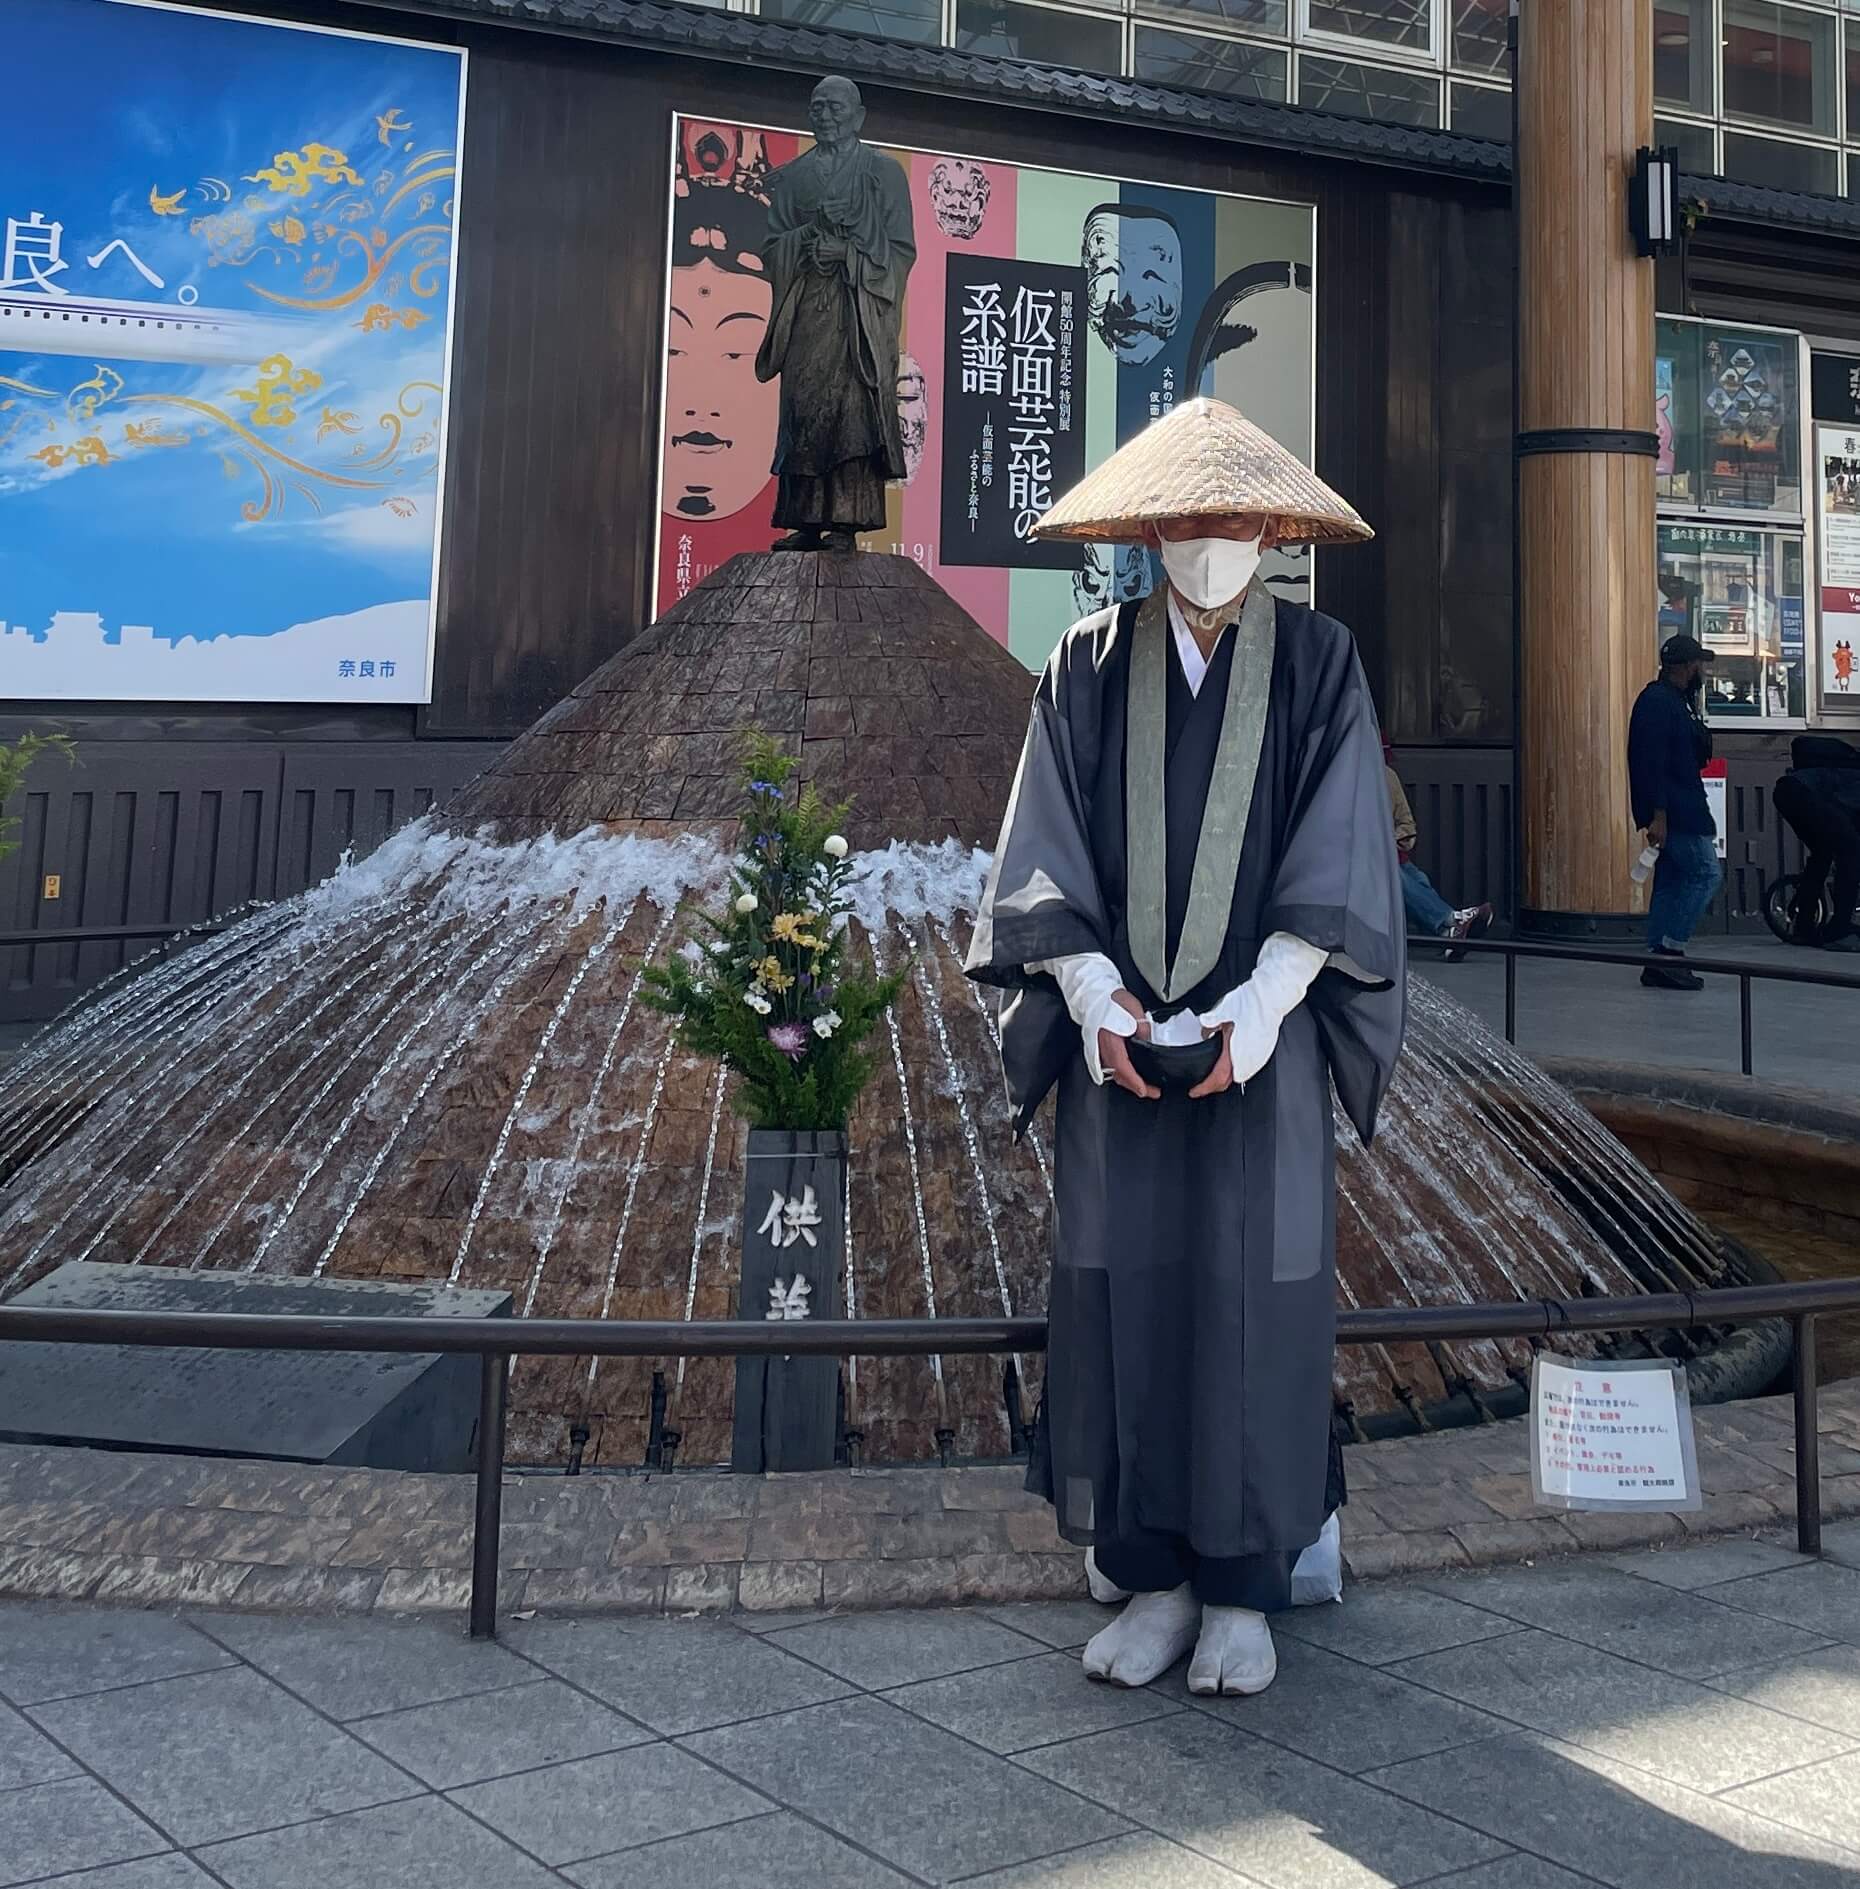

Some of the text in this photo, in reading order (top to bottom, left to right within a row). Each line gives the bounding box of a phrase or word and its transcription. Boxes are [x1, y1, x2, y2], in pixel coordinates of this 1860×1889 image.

[959, 282, 1008, 396] 系譜
[1007, 284, 1057, 544] 仮面芸能の
[675, 533, 694, 601] 奈良県立
[338, 659, 397, 678] 奈良市
